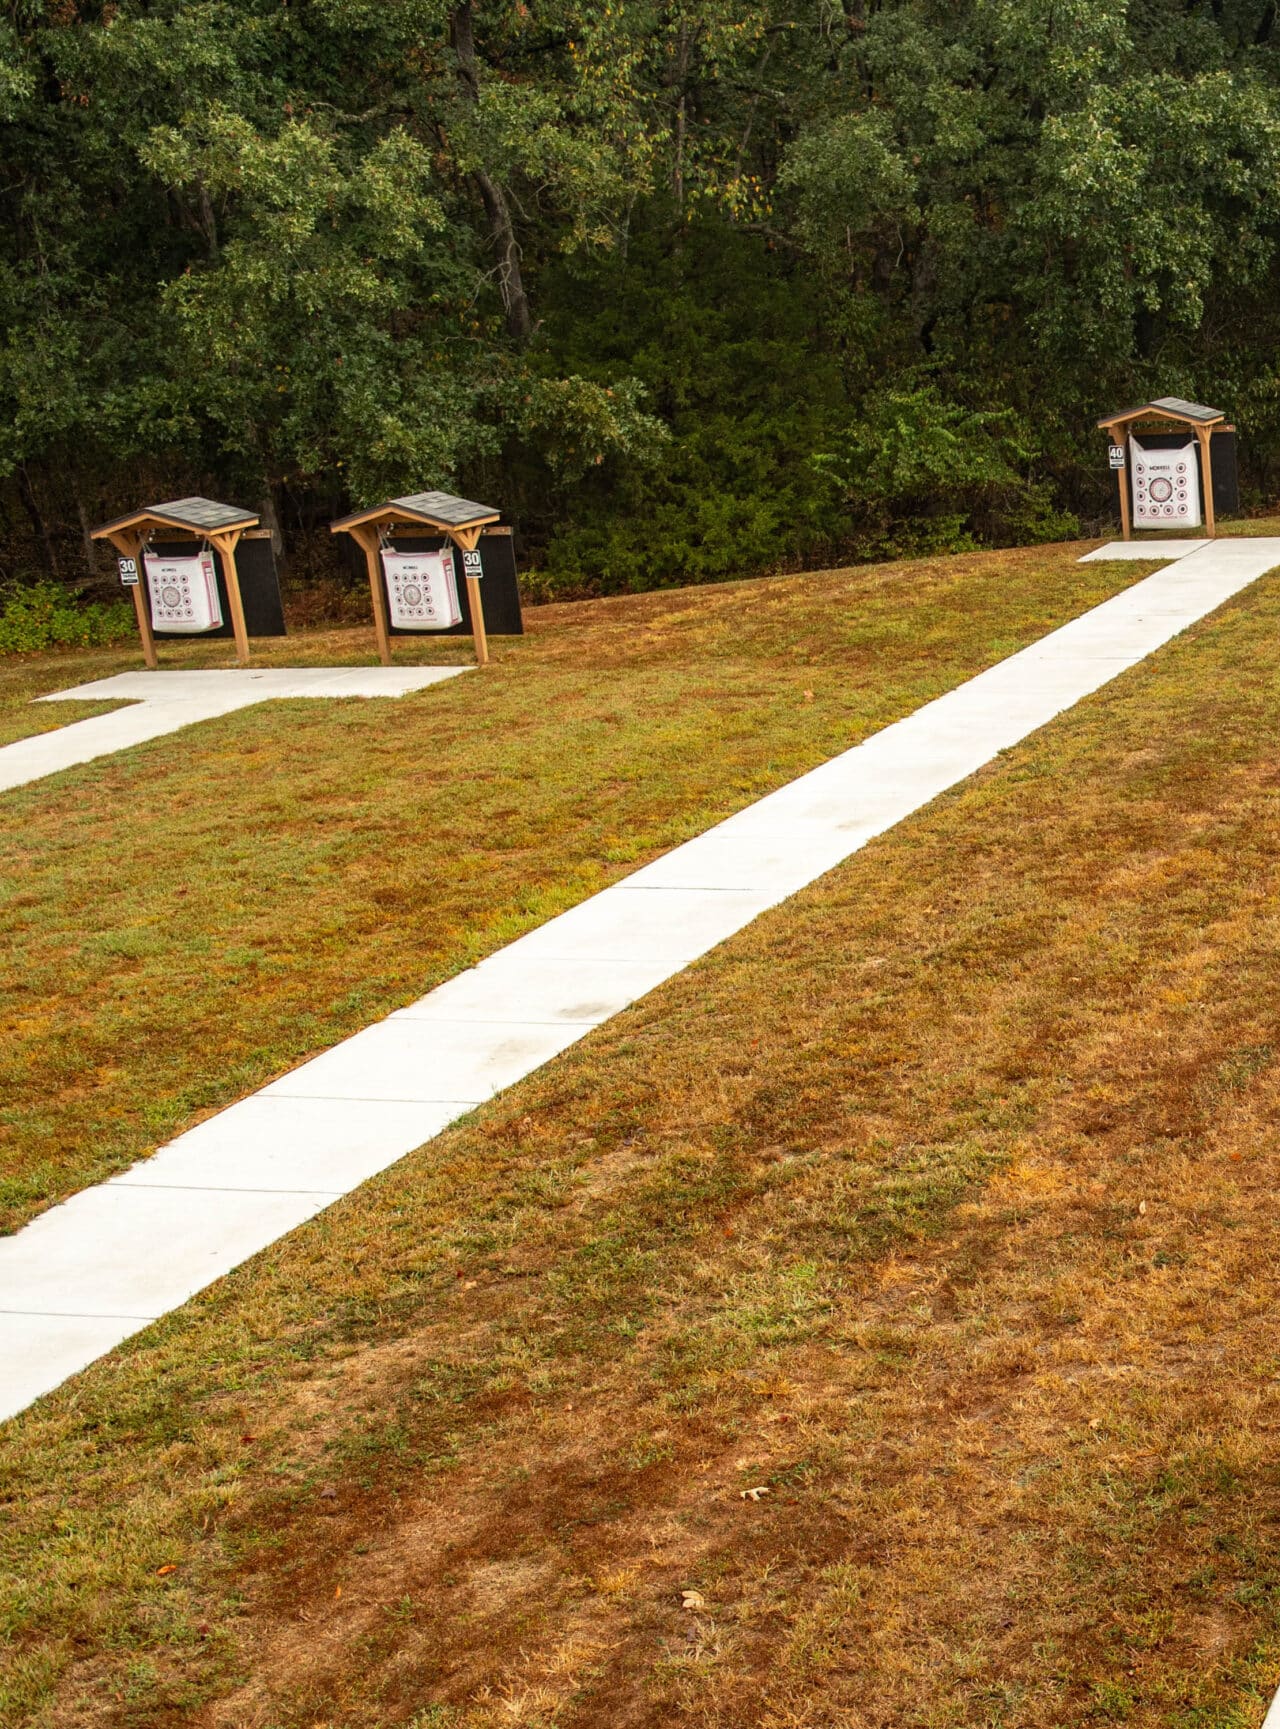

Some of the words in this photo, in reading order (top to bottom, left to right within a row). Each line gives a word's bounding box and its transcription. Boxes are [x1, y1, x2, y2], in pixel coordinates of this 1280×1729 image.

[1110, 447, 1123, 458] 40
[464, 552, 479, 565] 30
[120, 560, 135, 572] 30
